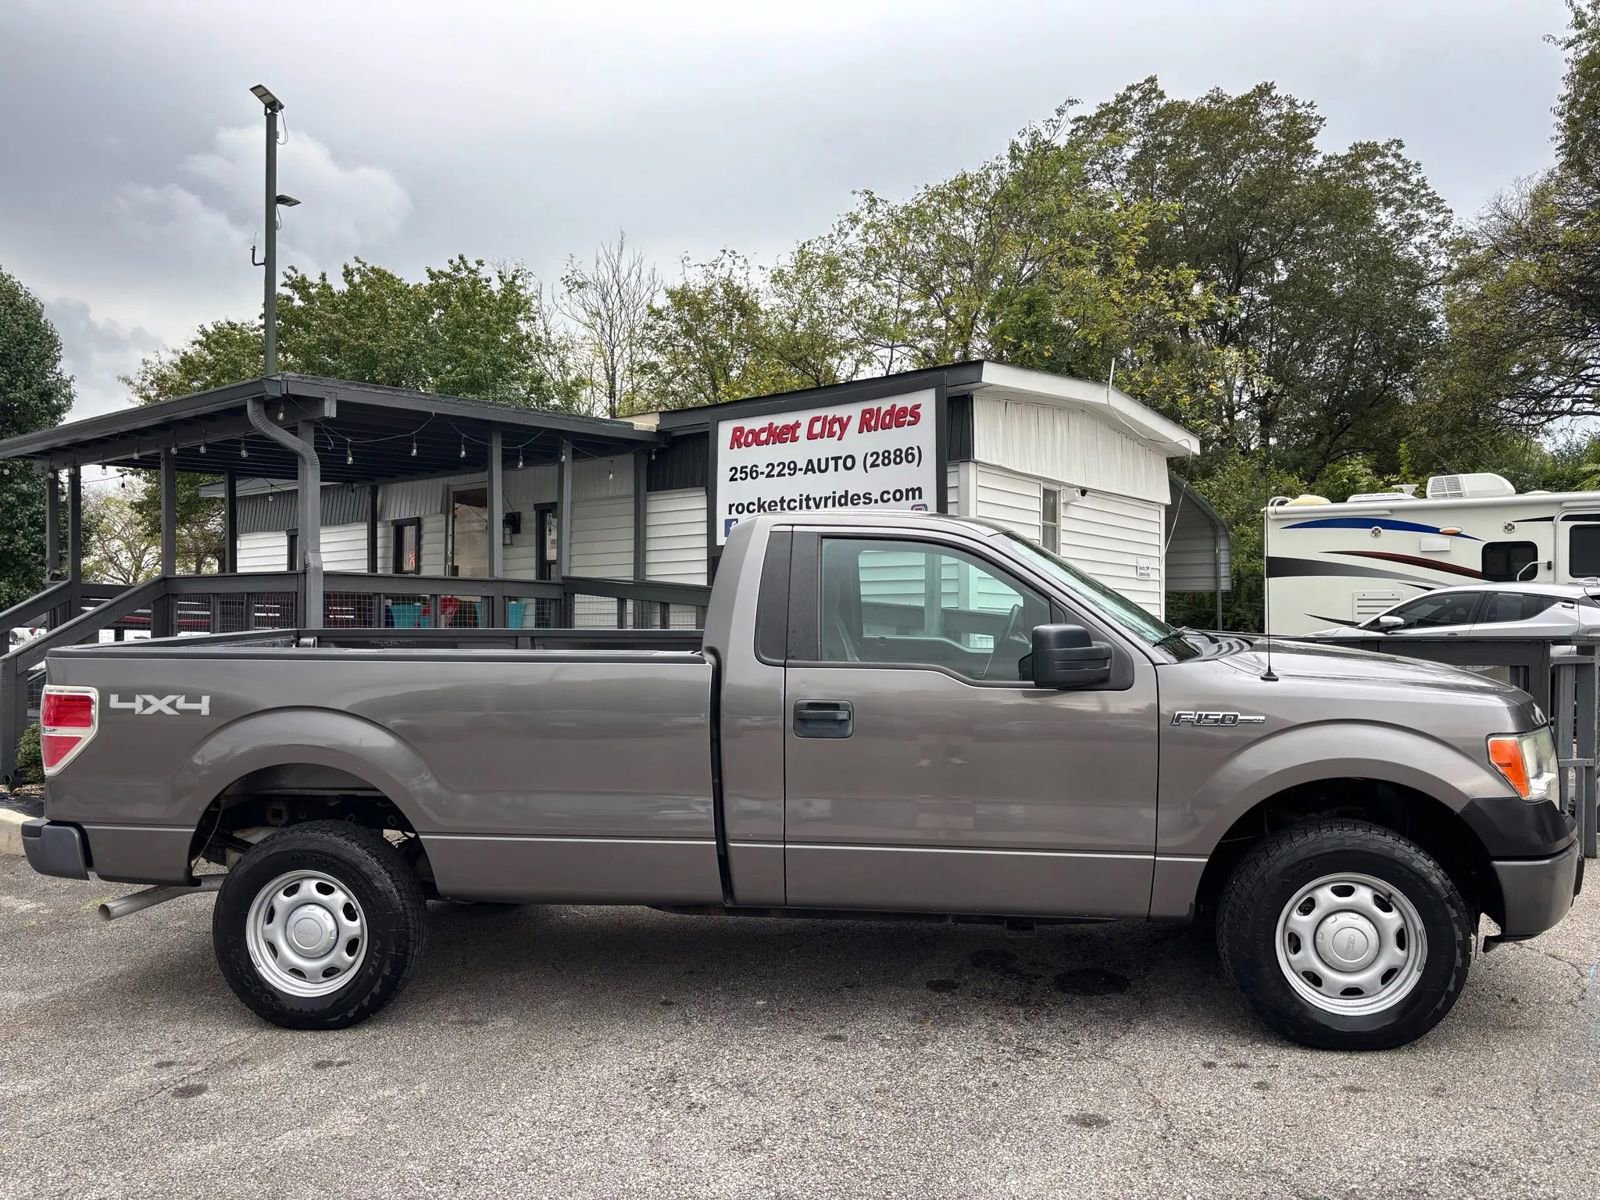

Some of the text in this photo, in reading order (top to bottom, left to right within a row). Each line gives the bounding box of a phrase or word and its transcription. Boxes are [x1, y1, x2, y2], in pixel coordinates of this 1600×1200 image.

[729, 403, 922, 449] Rocket City Rides
[728, 445, 923, 482] 256-229-AUTO (2886)
[728, 486, 923, 515] rocketcityrides.com
[1170, 710, 1241, 727] F-150
